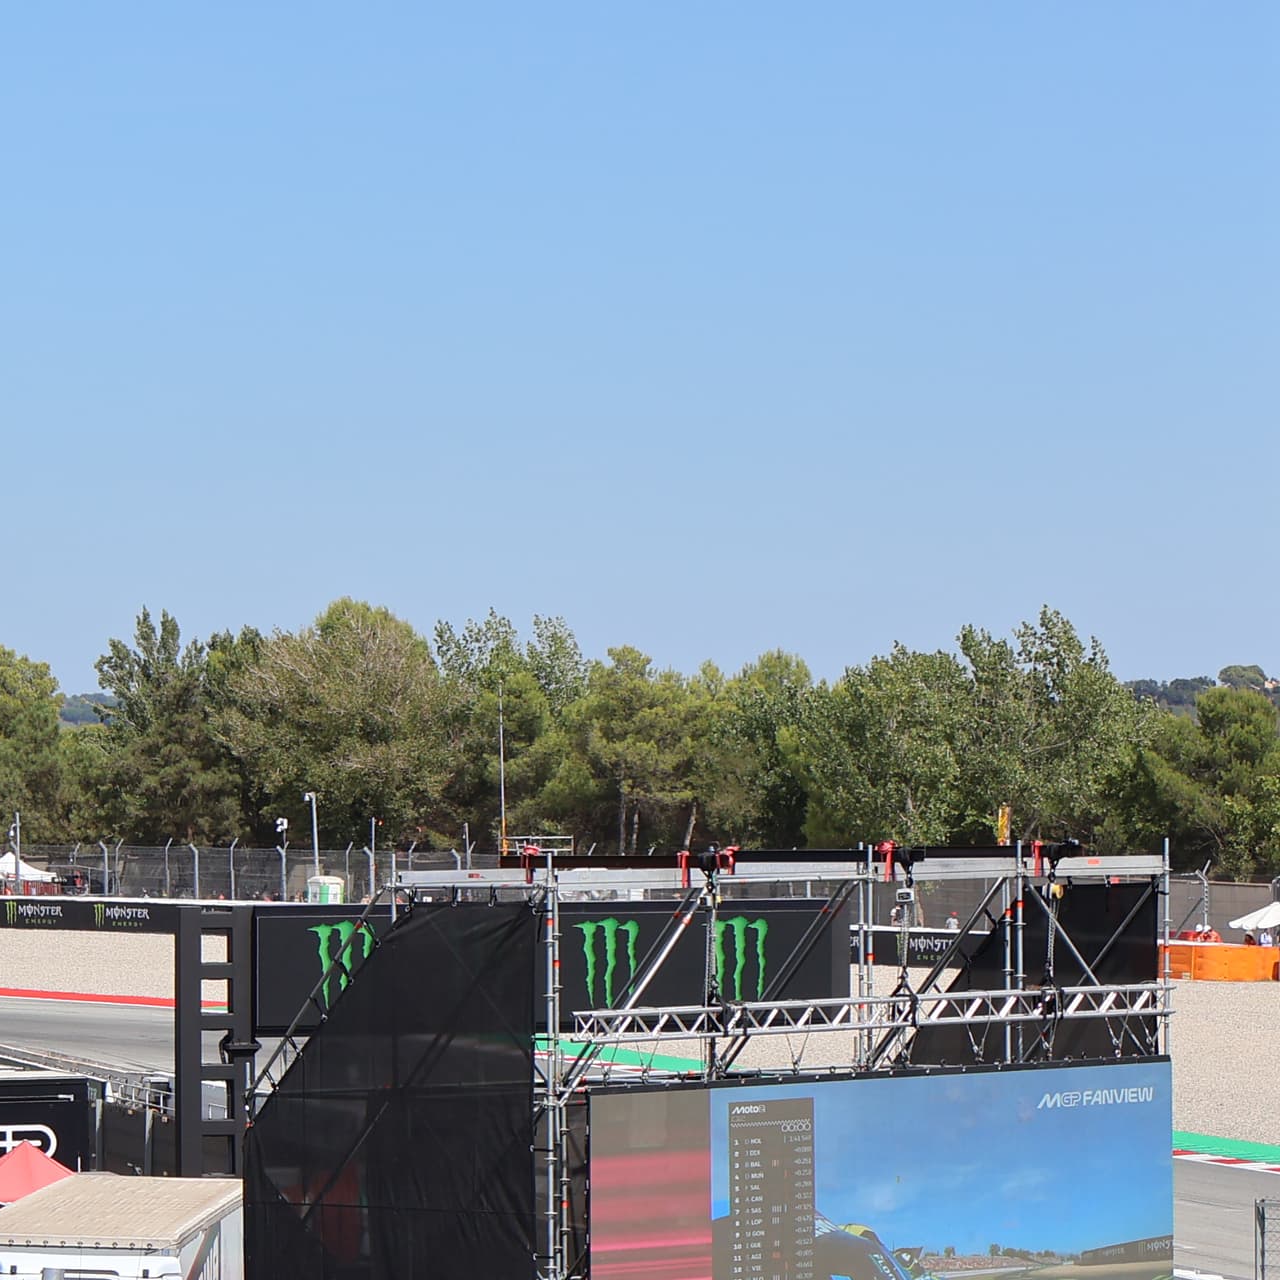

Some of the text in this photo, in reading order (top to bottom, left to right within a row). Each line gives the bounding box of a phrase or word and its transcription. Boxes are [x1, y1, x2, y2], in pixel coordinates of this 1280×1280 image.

[18, 904, 63, 917] MONSTER
[105, 906, 150, 920] MONSTER
[1083, 1087, 1154, 1105] FANVIEW
